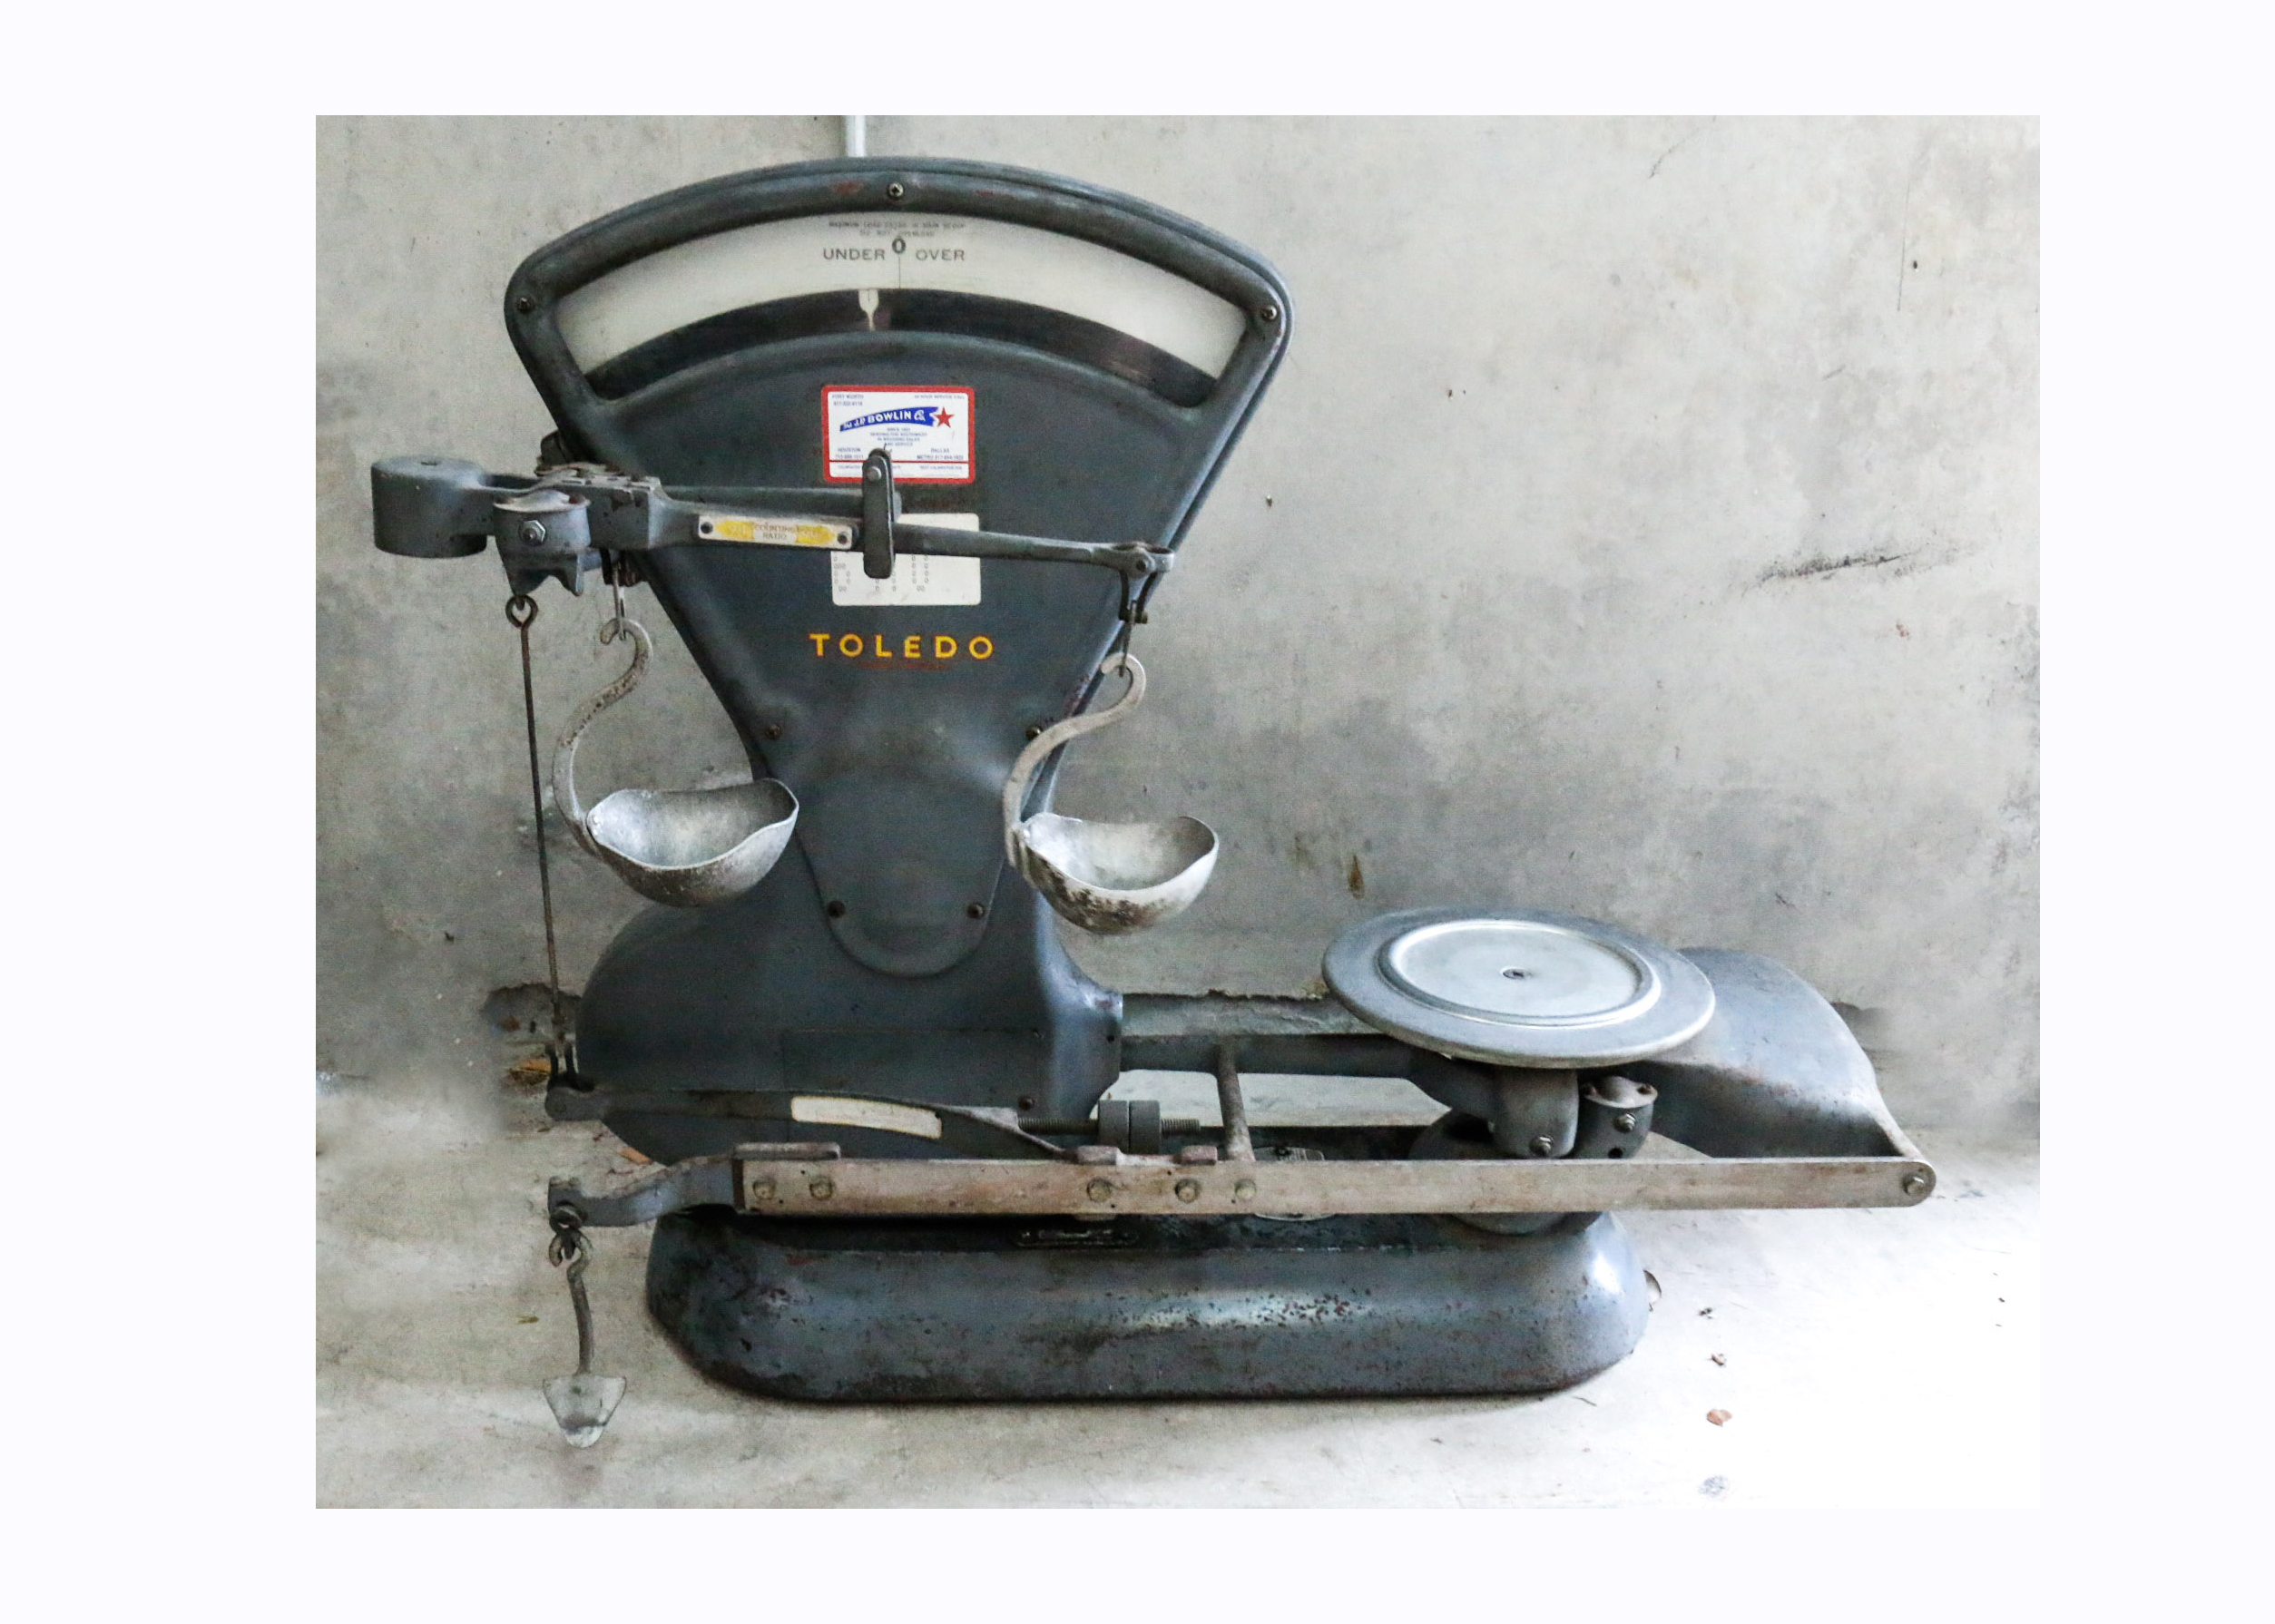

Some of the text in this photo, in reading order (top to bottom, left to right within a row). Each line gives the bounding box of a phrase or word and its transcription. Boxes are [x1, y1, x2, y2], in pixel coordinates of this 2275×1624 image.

[823, 238, 966, 261] UNDER 0 OVER
[868, 410, 912, 424] BOWLIN
[809, 633, 994, 660] TOLEDO
